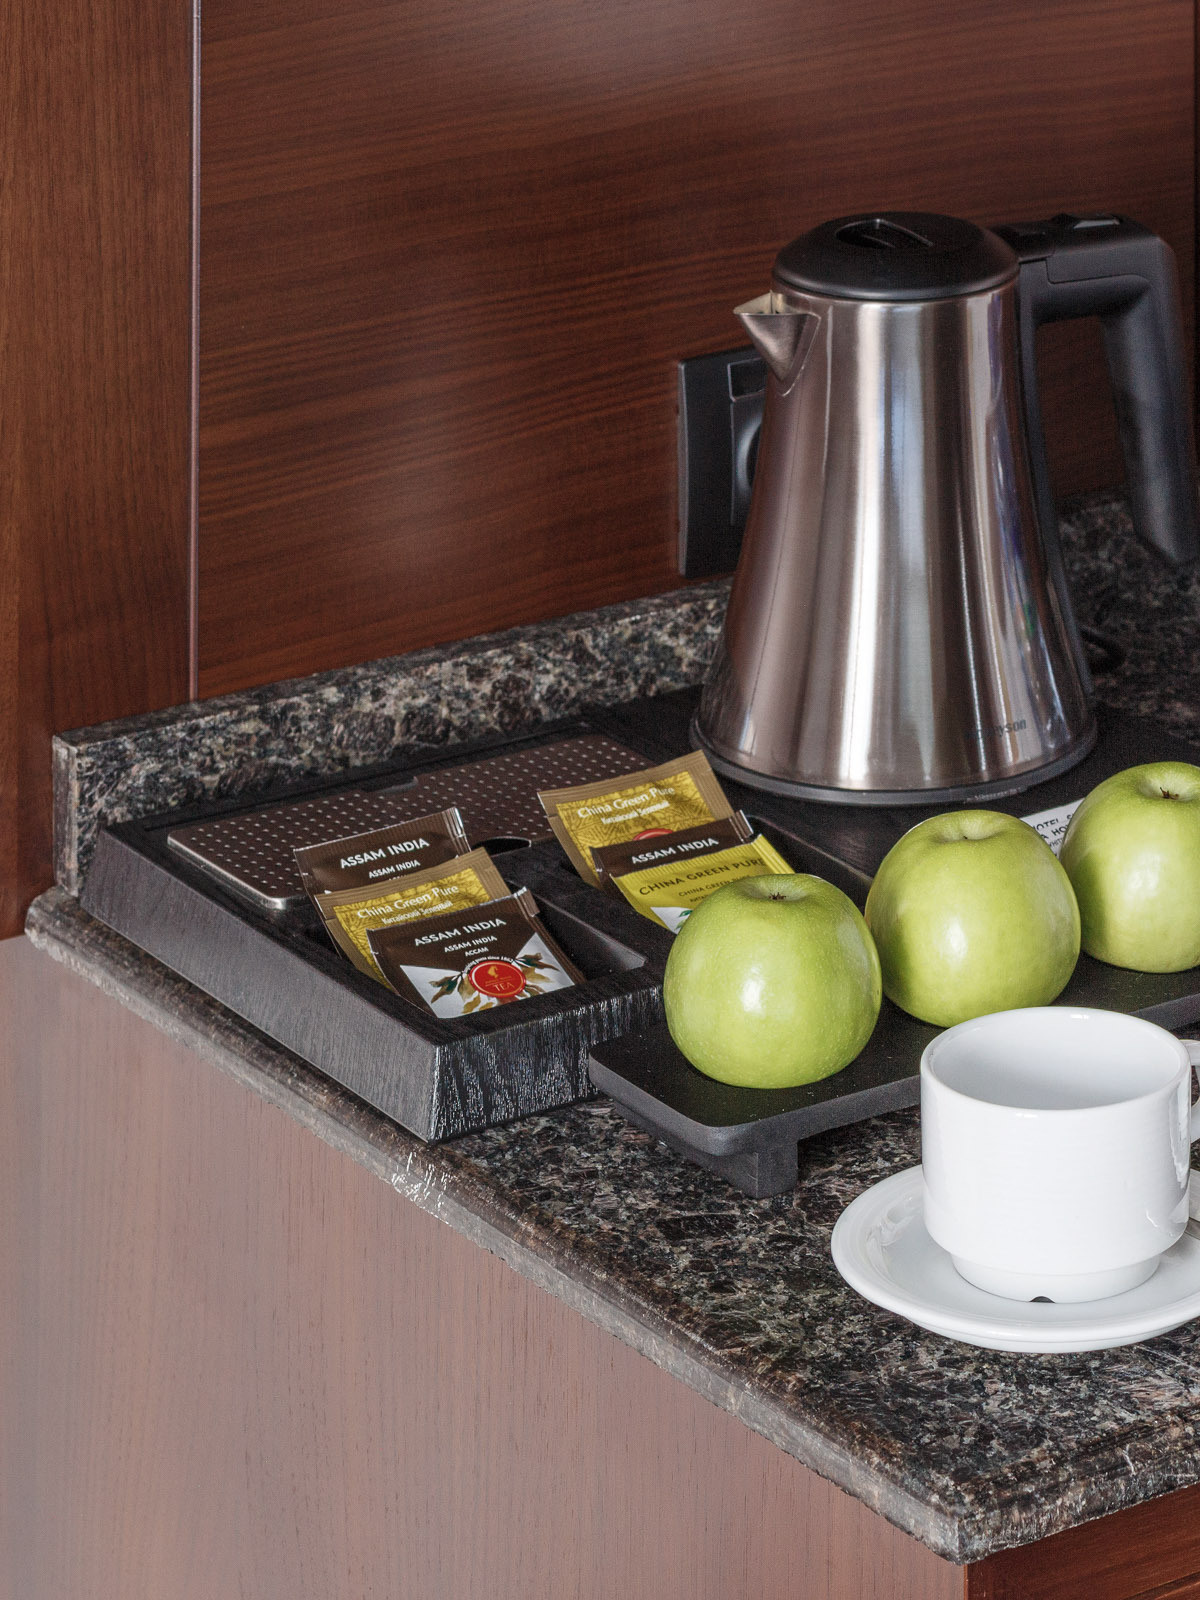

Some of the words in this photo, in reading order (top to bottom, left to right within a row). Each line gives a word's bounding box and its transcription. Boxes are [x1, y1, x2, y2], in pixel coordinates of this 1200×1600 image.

[577, 803, 612, 819] China
[613, 793, 649, 810] Green
[649, 787, 676, 798] Pure
[340, 848, 387, 869] ASSAM
[387, 838, 430, 856] INDIA
[631, 847, 677, 865] ASSAM
[677, 837, 720, 853] INDIA
[369, 866, 396, 878] ASSAM
[396, 860, 421, 871] INDIA
[639, 877, 685, 896] CHINA
[686, 865, 730, 881] GREEN
[734, 857, 767, 870] PURE
[357, 904, 393, 919] China
[394, 893, 431, 910] Green
[431, 886, 459, 897] Pure
[678, 886, 705, 897] CHINA
[414, 928, 461, 946] ASSAM
[463, 918, 507, 934] INDIA
[444, 941, 471, 953] ASSAM
[472, 935, 497, 946] INDIA
[492, 982, 516, 992] TEA
